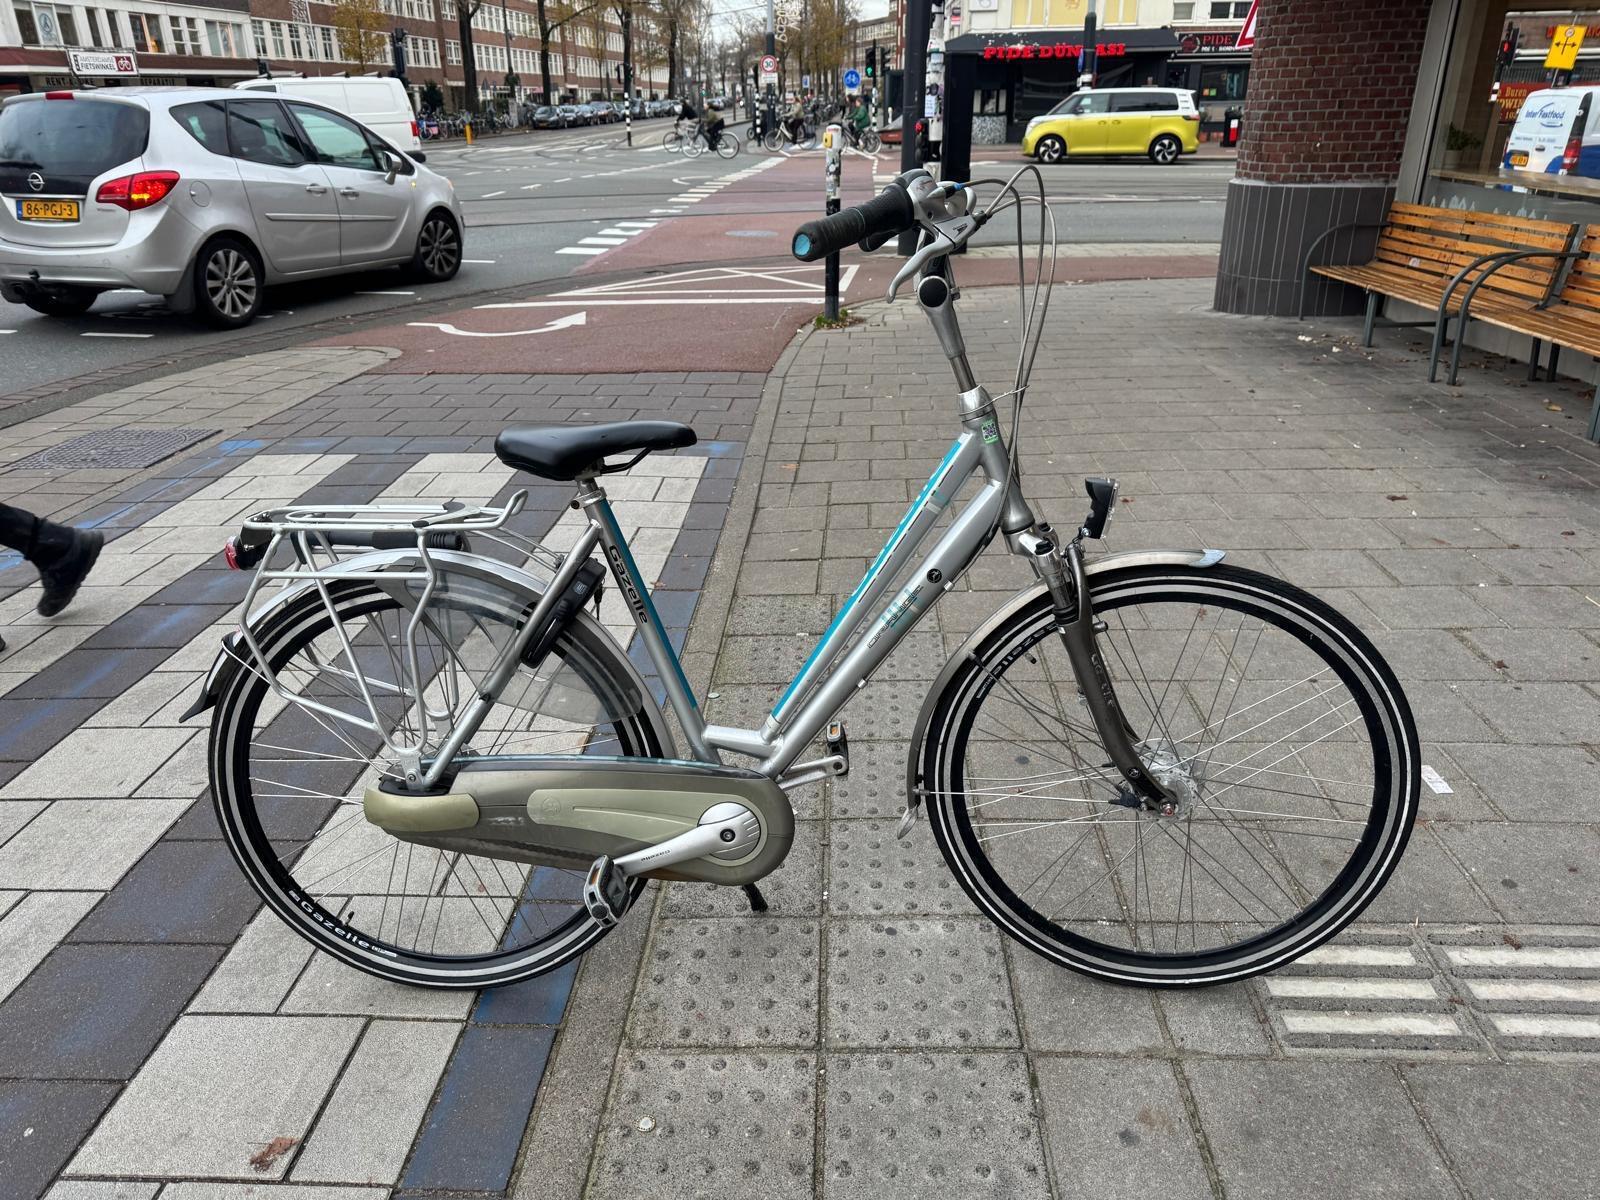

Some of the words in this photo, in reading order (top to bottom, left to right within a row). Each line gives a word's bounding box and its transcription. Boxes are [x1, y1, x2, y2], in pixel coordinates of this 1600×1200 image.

[1202, 35, 1233, 45] PIDE
[984, 46, 1034, 59] PIDE
[1038, 42, 1126, 58] DÜNASI
[80, 62, 117, 71] FIETSWINKEL
[765, 60, 774, 68] 30
[26, 203, 74, 217] 86-PGJ-3
[608, 545, 648, 624] Gazelle
[300, 900, 370, 949] Gazelle
